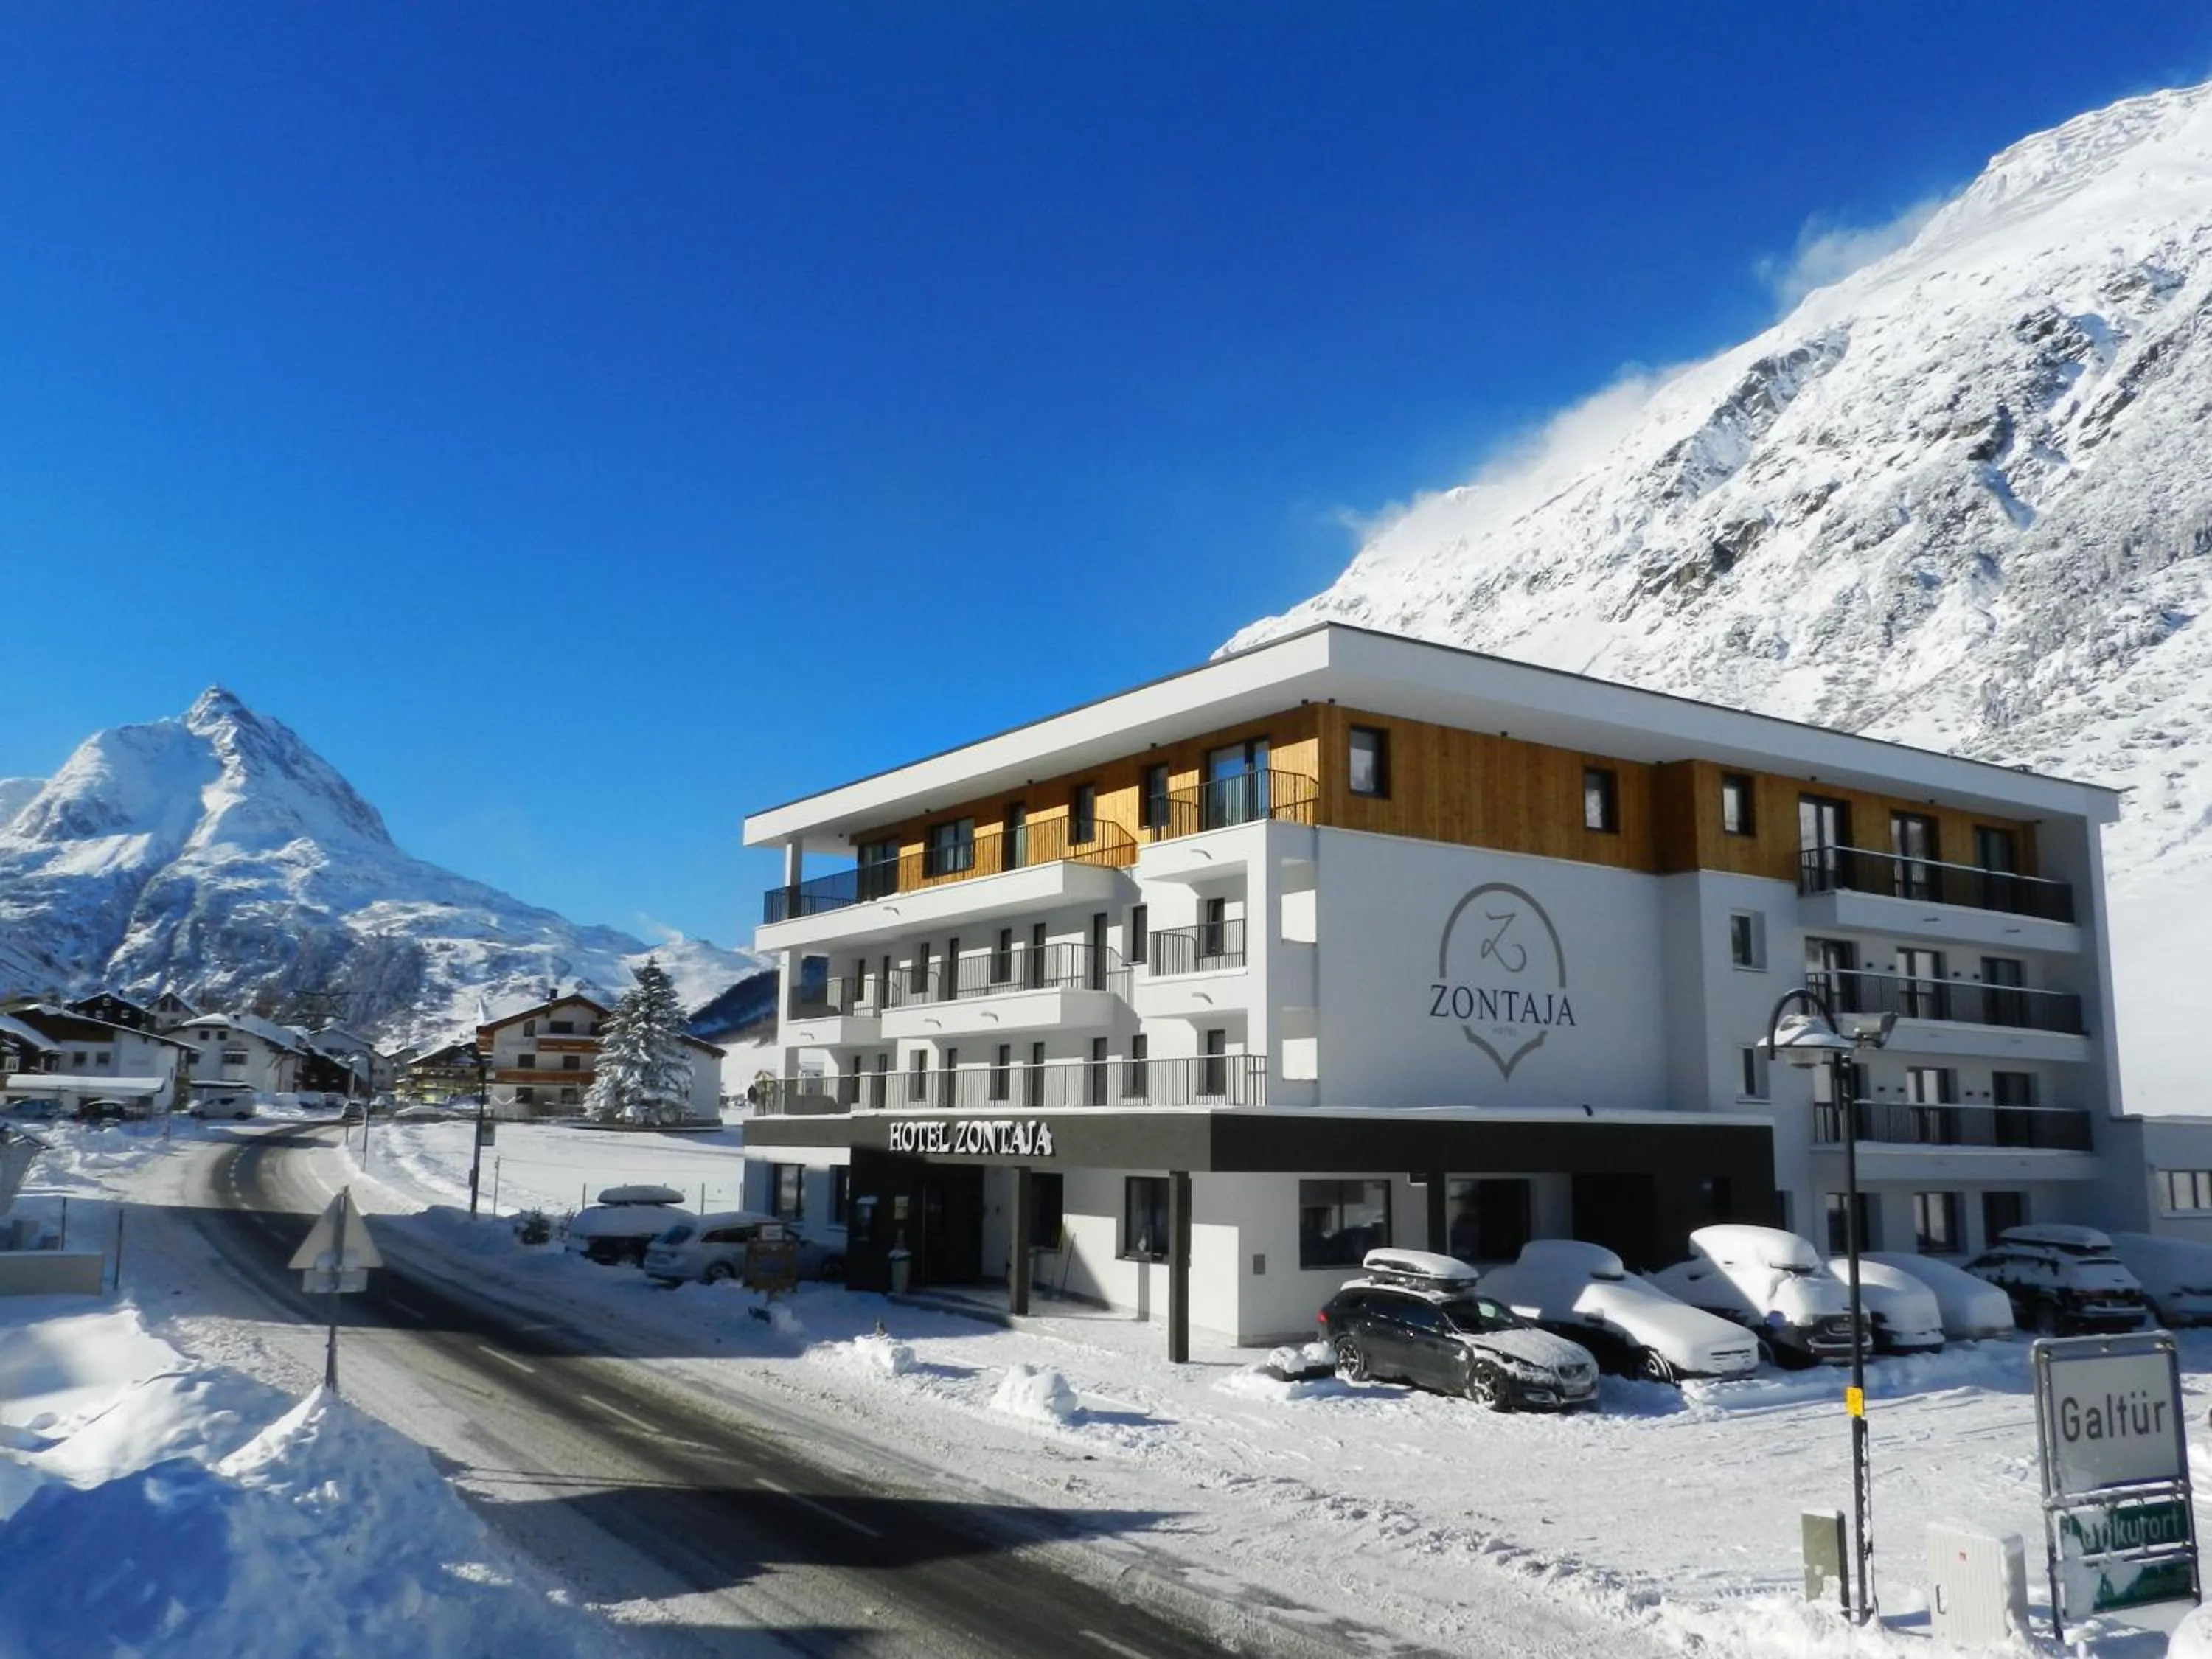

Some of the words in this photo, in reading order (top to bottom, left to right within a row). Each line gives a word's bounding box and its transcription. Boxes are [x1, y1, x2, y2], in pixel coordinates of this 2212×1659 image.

[1430, 984, 1576, 1026] ZONTAJA
[889, 1121, 950, 1152] HOTEL
[954, 1120, 1053, 1155] ZONTAJA
[2061, 1391, 2166, 1442] Galtür
